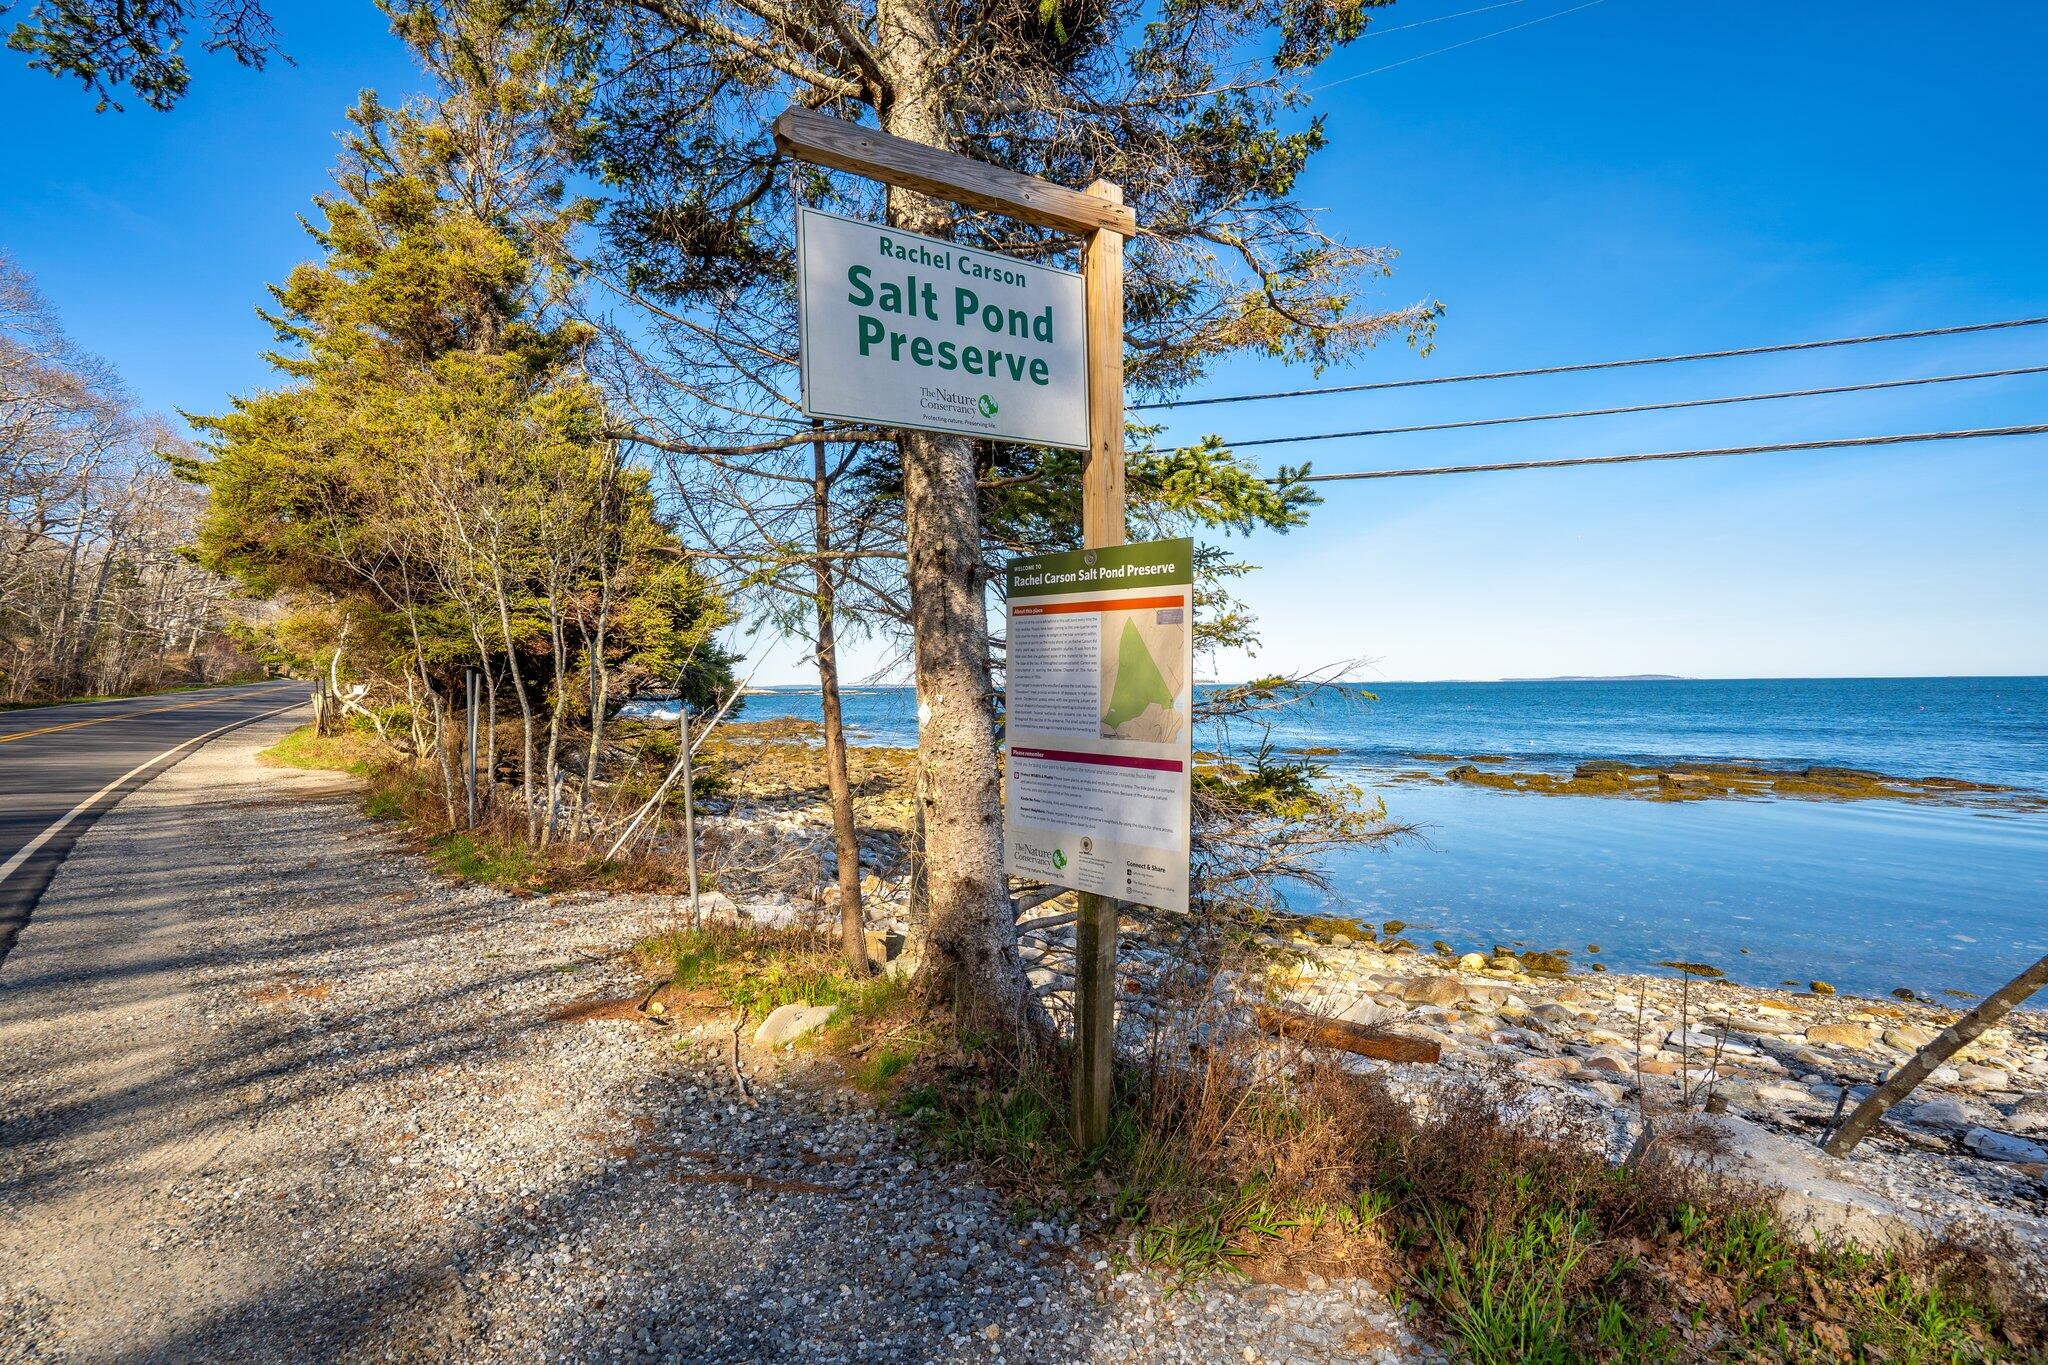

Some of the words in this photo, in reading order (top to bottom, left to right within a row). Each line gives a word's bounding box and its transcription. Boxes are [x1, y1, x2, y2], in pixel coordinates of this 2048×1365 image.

[880, 236, 950, 271] Rachel
[958, 256, 1026, 288] Carson
[847, 264, 939, 321] Salt
[955, 287, 1054, 344] Pond
[858, 314, 1050, 386] Preserve
[920, 387, 936, 398] The
[936, 388, 977, 406] Nature
[920, 398, 977, 418] Conservancy
[1014, 573, 1043, 587] Rachel
[1044, 572, 1076, 584] Carson
[1078, 568, 1098, 581] Salt
[1099, 565, 1125, 579] Pond
[1127, 562, 1175, 577] Preserve
[1014, 852, 1051, 869] Conservancy
[1015, 843, 1025, 851] The
[1024, 844, 1052, 858] Nature
[1126, 860, 1147, 870] Connect
[1151, 865, 1166, 873] Share
